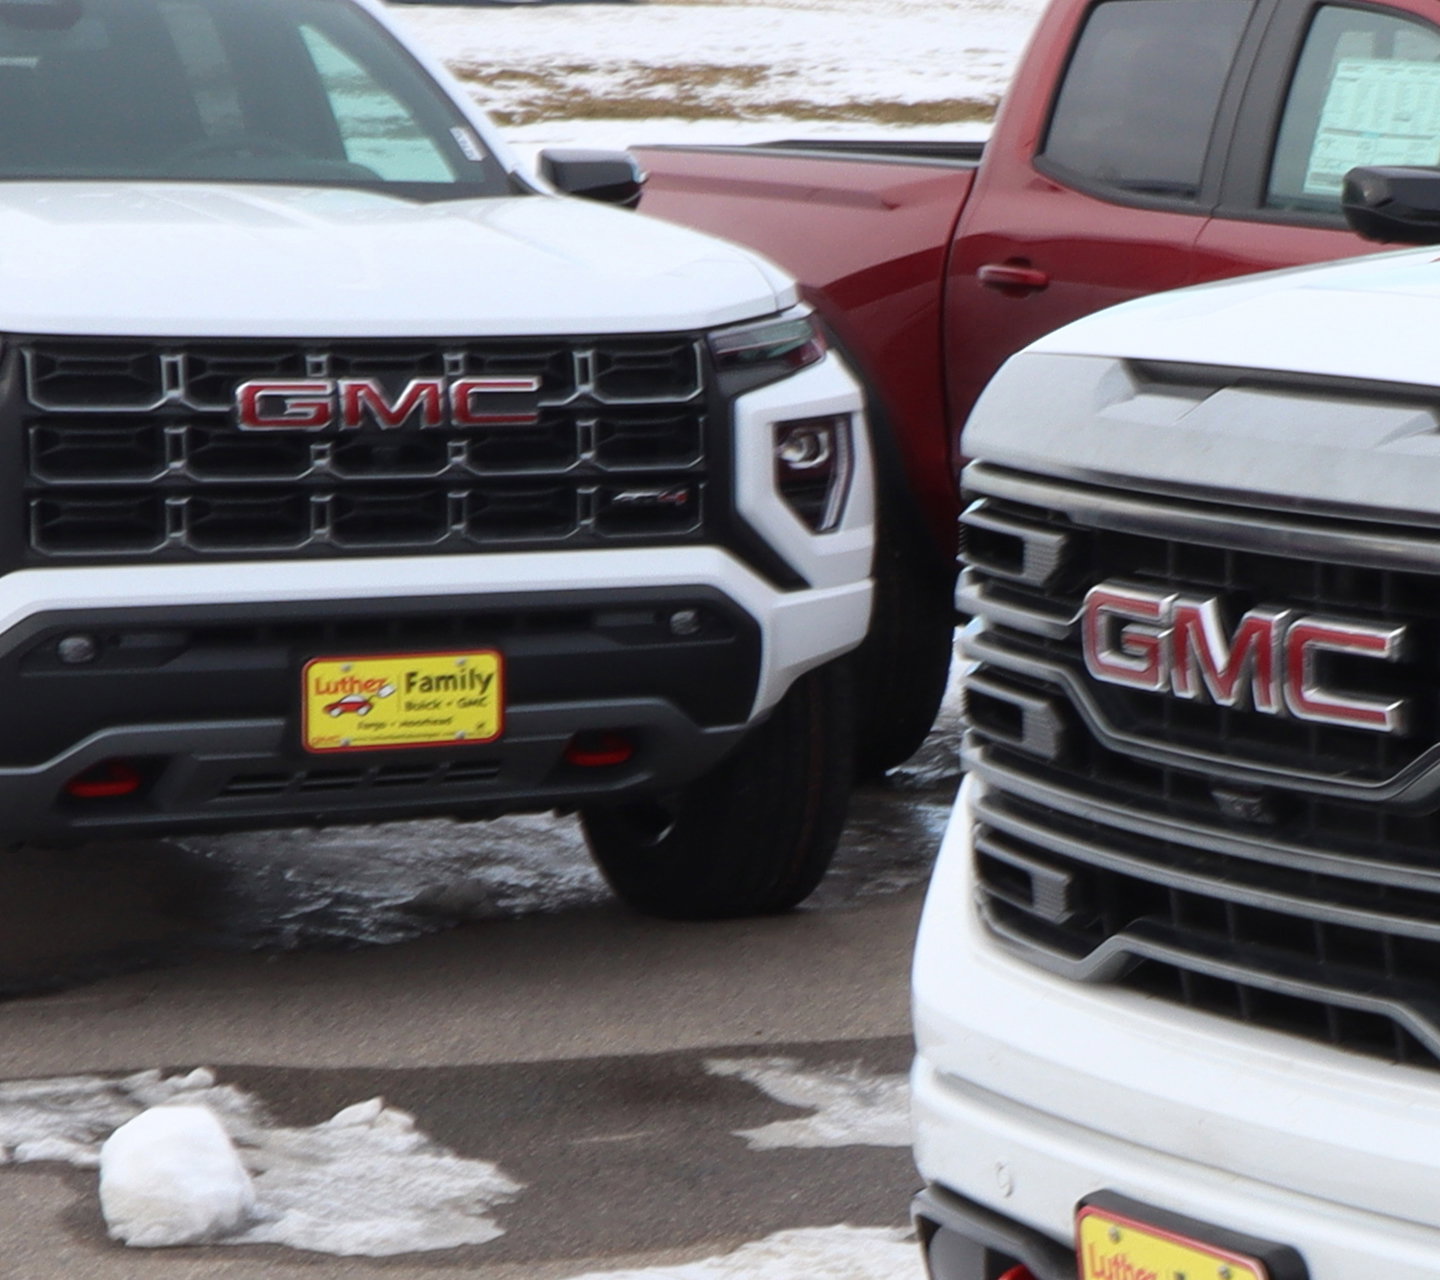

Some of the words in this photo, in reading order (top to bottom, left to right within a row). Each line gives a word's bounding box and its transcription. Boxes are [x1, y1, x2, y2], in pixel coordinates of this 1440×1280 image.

[235, 376, 543, 432] GMC
[1082, 579, 1406, 734] GMC
[314, 674, 389, 696] Luther
[405, 667, 494, 695] Family
